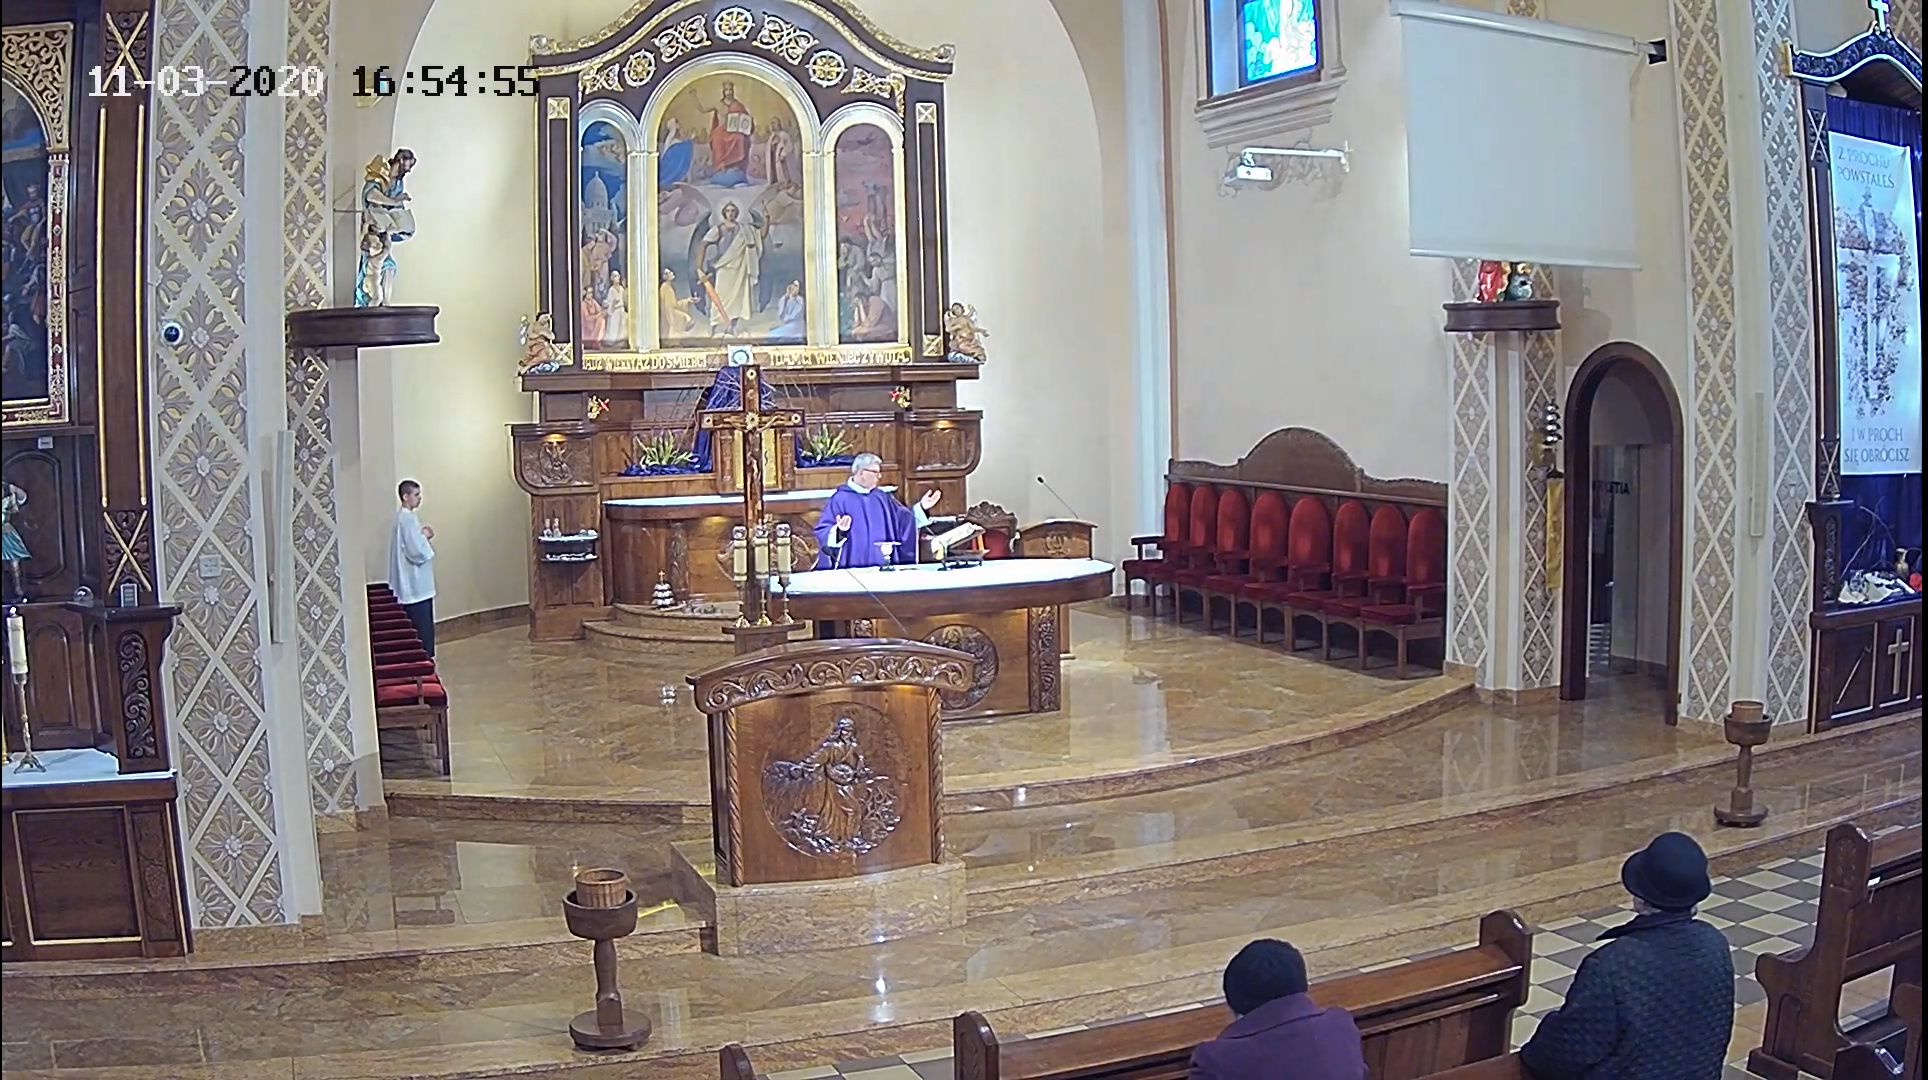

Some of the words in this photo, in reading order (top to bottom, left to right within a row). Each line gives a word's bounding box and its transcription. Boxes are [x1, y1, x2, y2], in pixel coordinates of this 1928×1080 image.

[1847, 149, 1890, 169] PROCHU
[1857, 427, 1866, 441] W
[1867, 427, 1904, 442] PROCH
[1844, 447, 1860, 466] SIĘ
[1861, 445, 1910, 463] OBRÓCISZ
